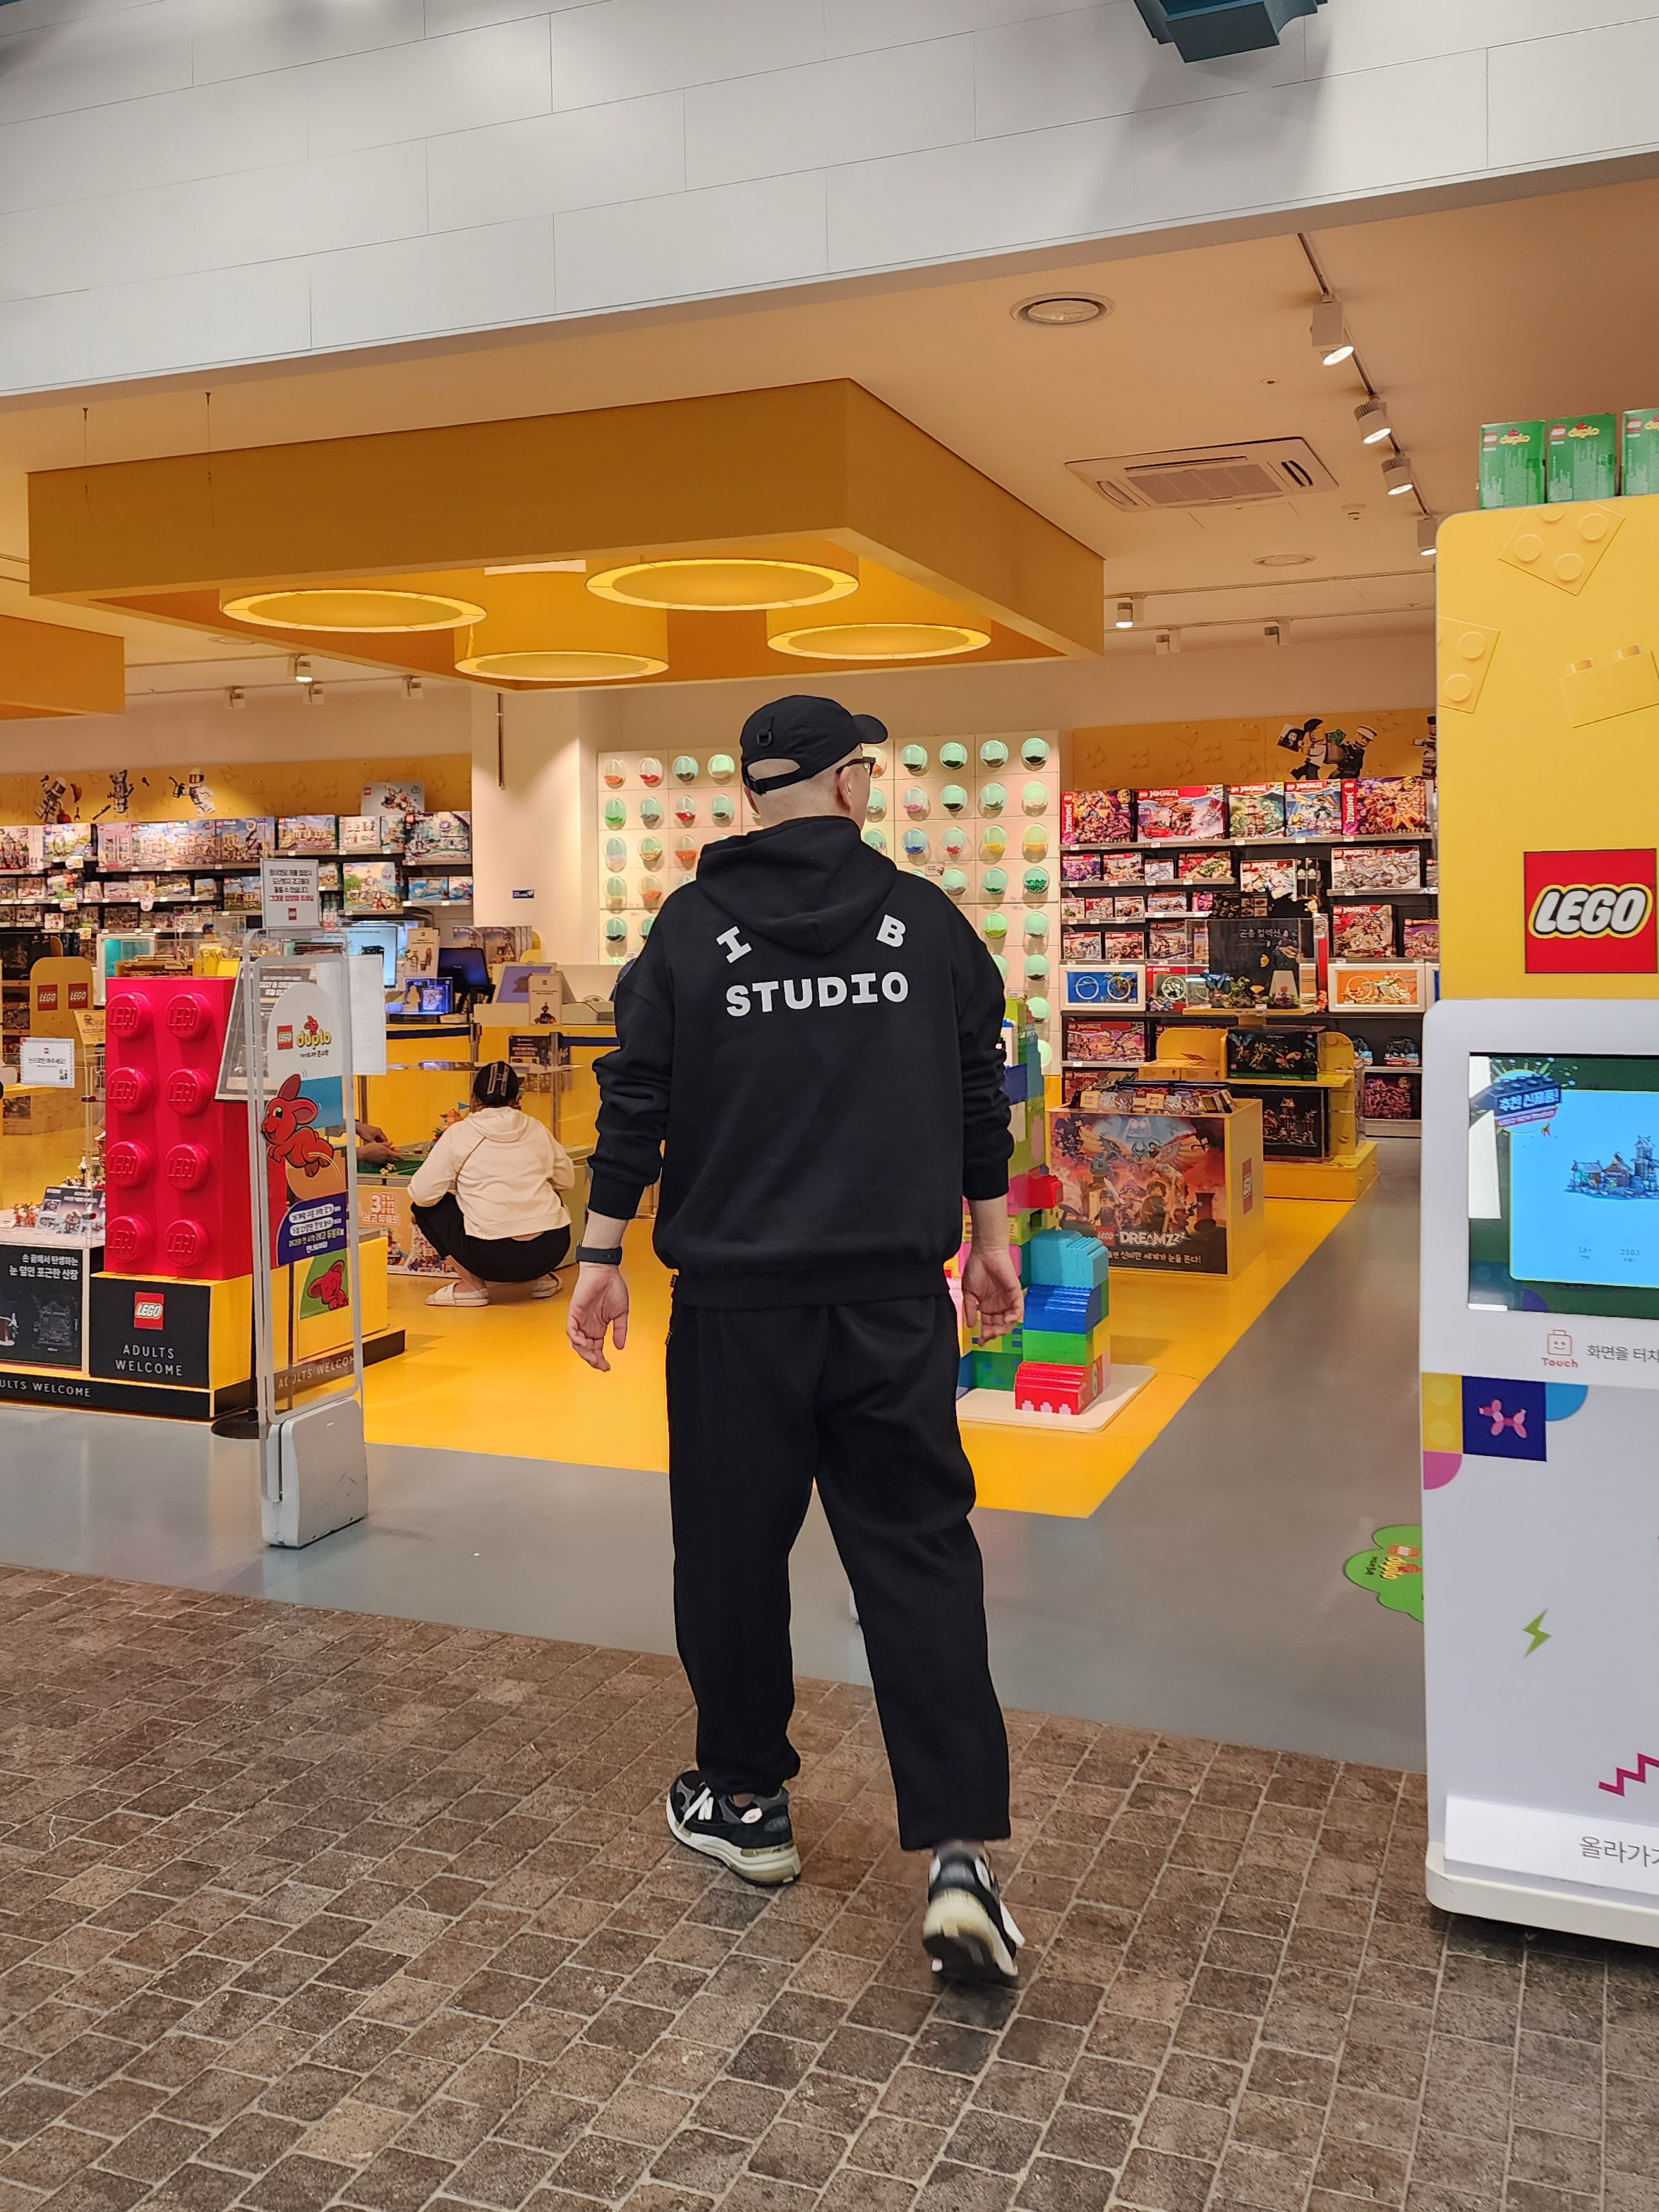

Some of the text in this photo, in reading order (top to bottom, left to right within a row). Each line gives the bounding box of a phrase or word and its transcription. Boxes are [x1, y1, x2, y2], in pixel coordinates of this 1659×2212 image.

[1150, 789, 1179, 798] NINJAGO
[1531, 886, 1649, 935] LEGO
[716, 914, 906, 963] I B
[1240, 928, 1281, 938] 곤충 컬렉션
[39, 992, 56, 1002] LEGO
[70, 990, 87, 1001] LEGO
[725, 971, 909, 1017] STUDIO
[296, 1029, 332, 1050] duplo
[1499, 1088, 1560, 1112] 추천 신제품!
[370, 1194, 382, 1213] 3
[21, 1254, 78, 1266] 손 끝에서 탄생하는
[9, 1265, 78, 1280] 눈 덮인 포근한 산장
[135, 1303, 162, 1318] LEGO
[123, 1344, 175, 1359] ADULTS
[1587, 1344, 1659, 1363] 화면을 터치
[115, 1359, 183, 1376] WELCOME
[1541, 1357, 1579, 1368] Touch
[32, 1382, 91, 1397] WELCOME
[1378, 1556, 1407, 1580] duplo
